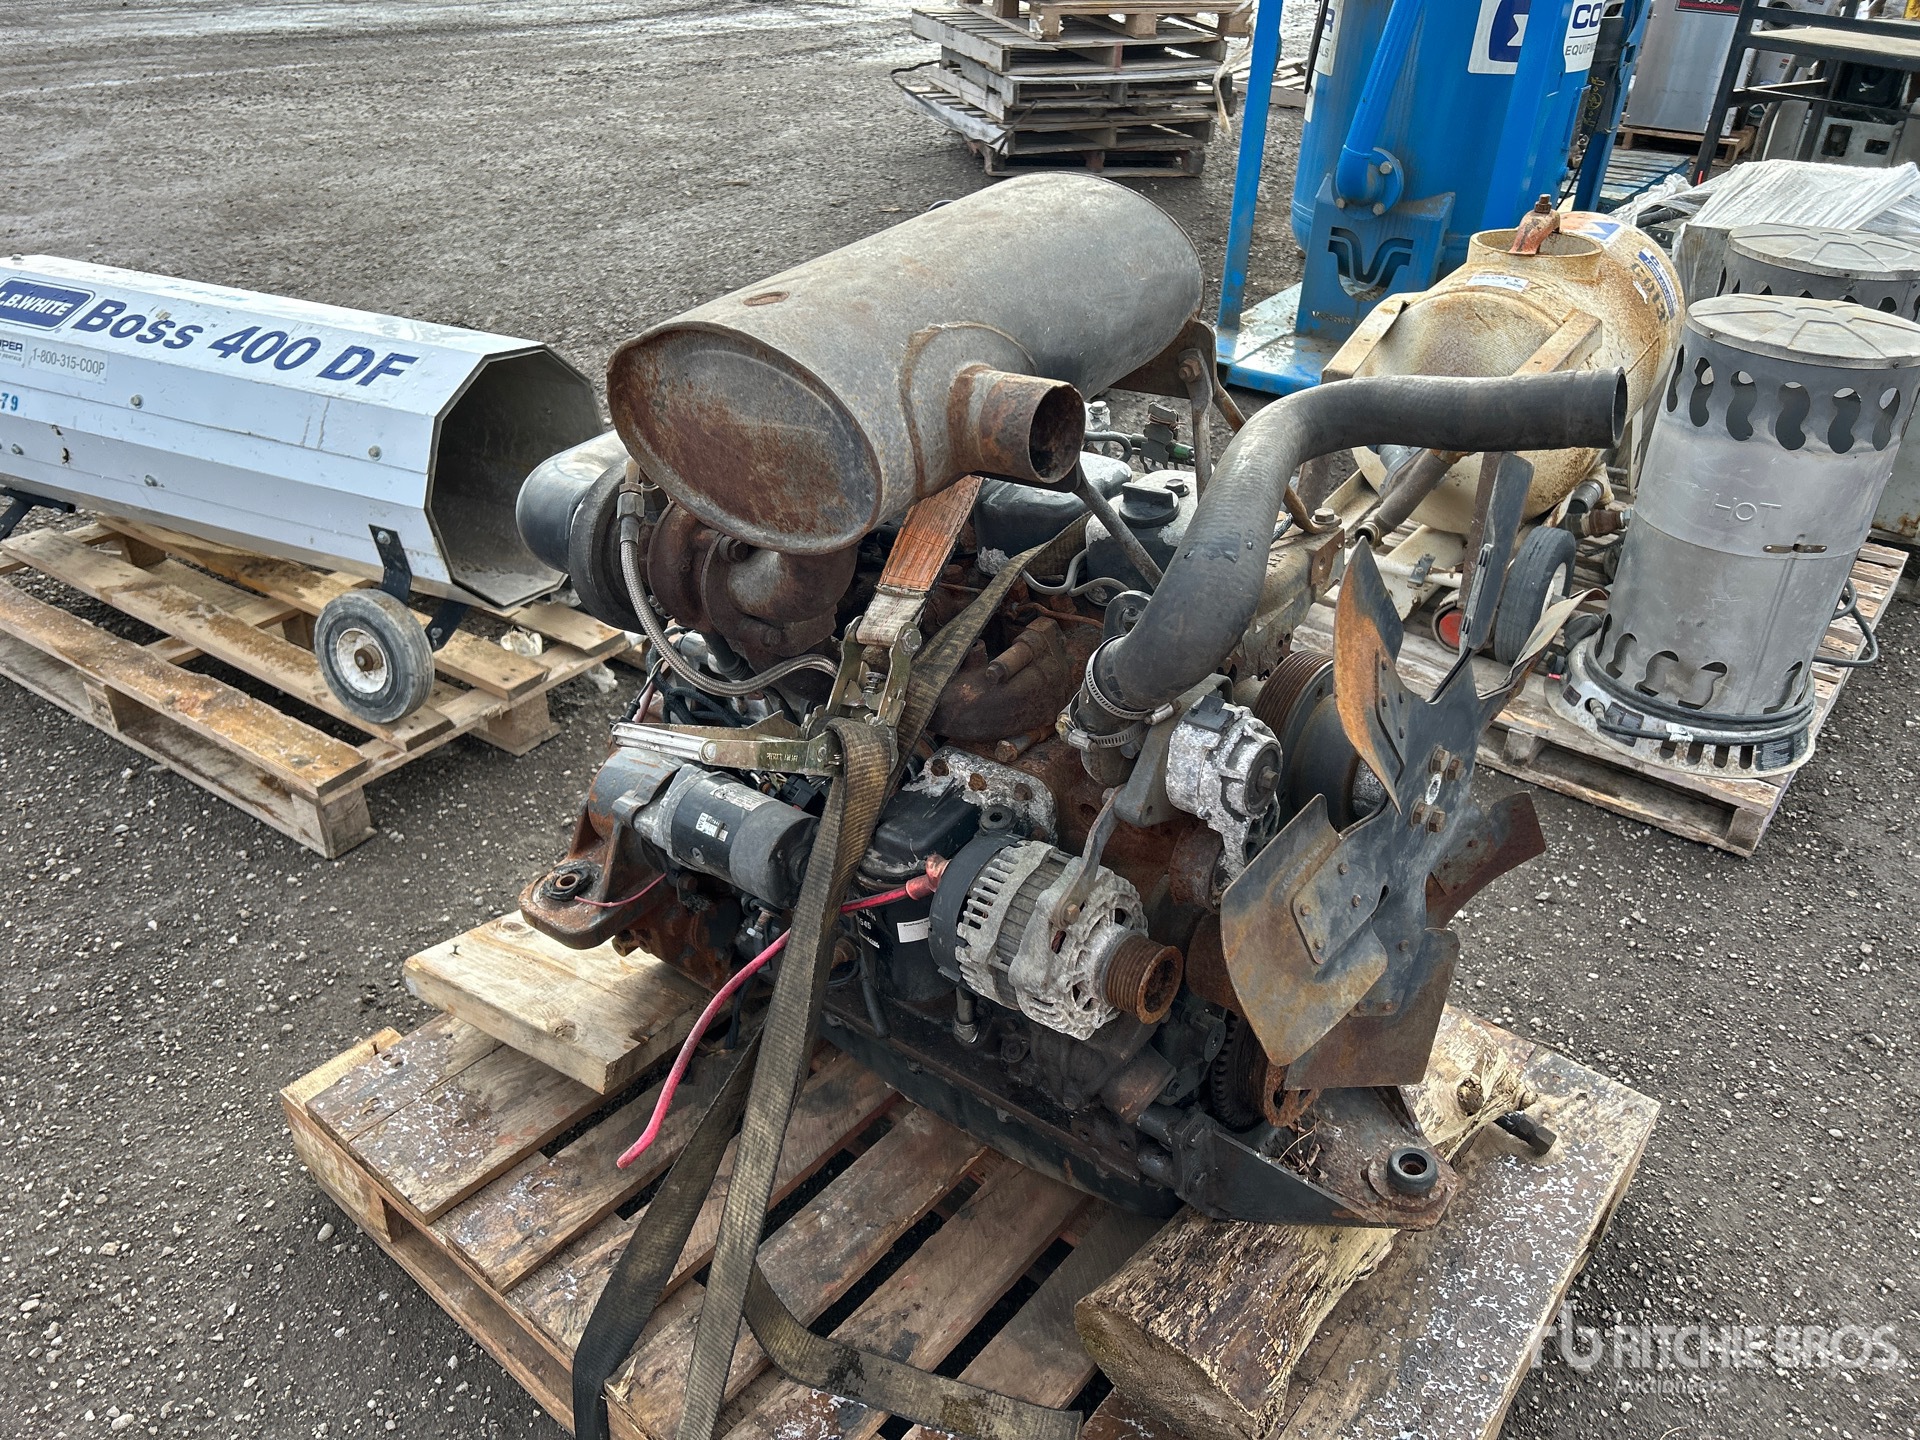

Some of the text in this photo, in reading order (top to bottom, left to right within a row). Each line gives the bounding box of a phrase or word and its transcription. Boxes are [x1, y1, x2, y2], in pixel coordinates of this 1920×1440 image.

[30, 347, 106, 376] 1-800-315-COOP
[207, 326, 322, 371] 400
[316, 345, 420, 387] DF
[1708, 492, 1783, 530] HOT
